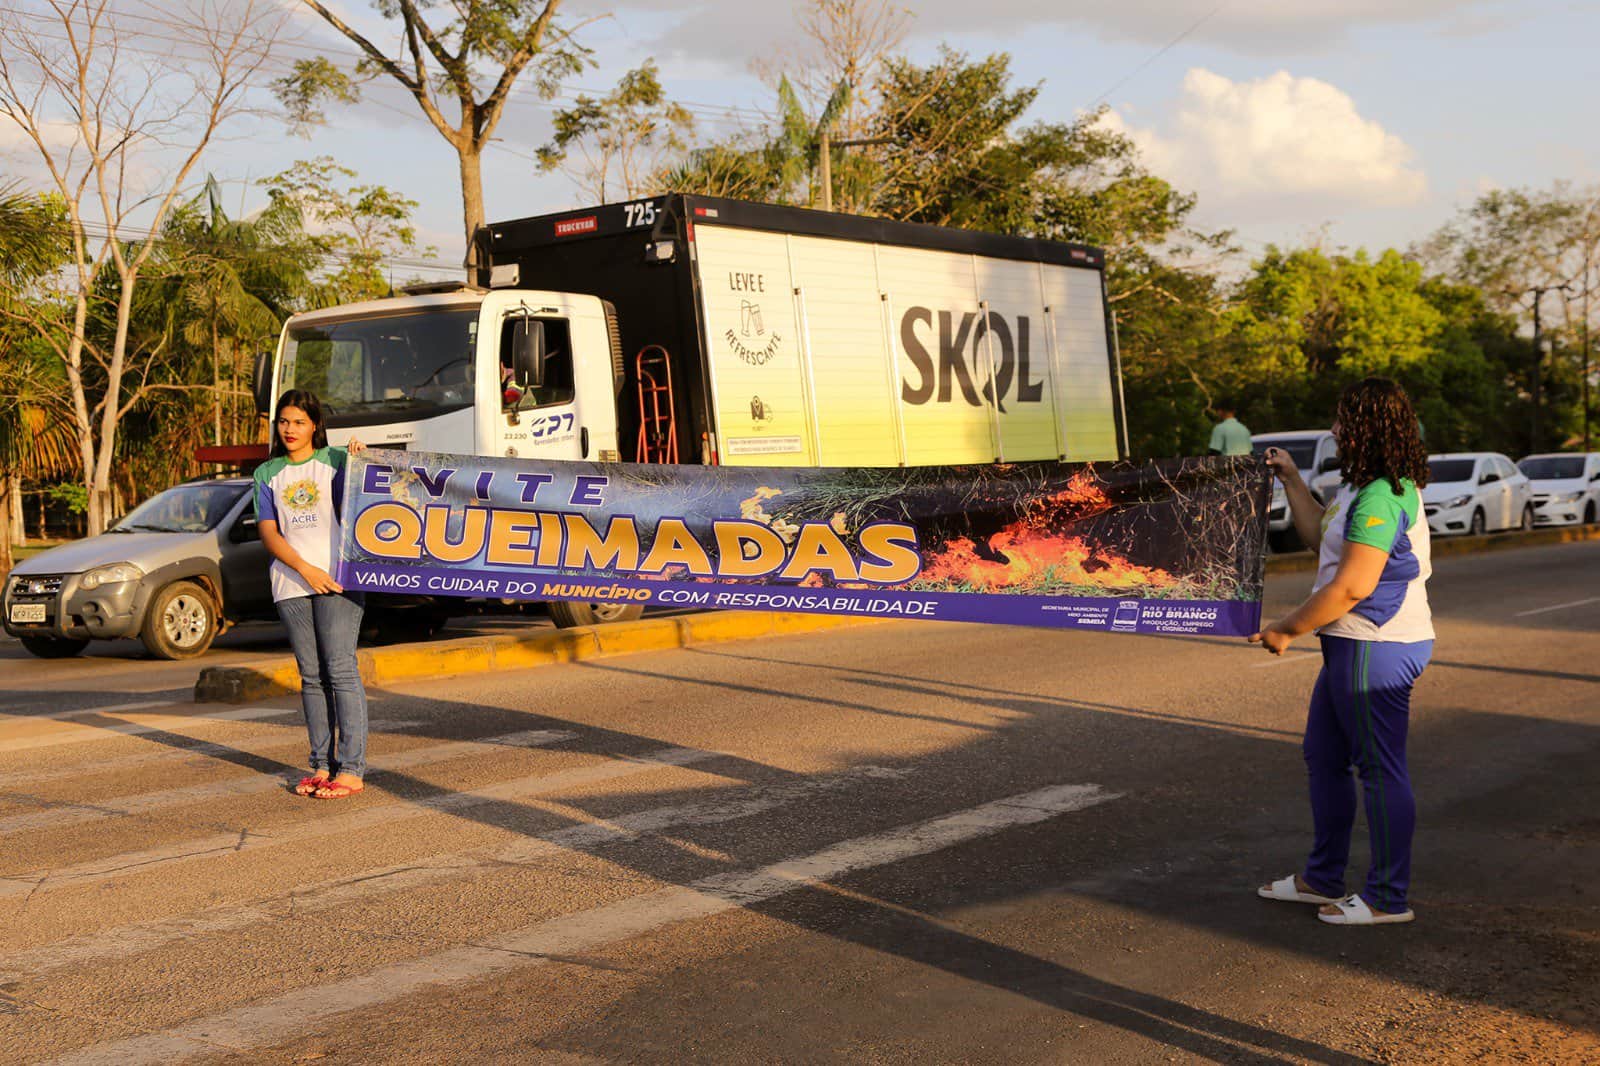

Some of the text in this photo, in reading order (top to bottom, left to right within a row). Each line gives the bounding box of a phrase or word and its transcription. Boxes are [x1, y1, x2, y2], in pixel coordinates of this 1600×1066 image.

[729, 271, 765, 293] LEVE E
[725, 329, 781, 366] REFRESCANTE
[362, 463, 609, 506] EVITE
[292, 513, 318, 524] ACRE
[353, 502, 922, 584] QUEIMADAS
[355, 571, 939, 616] VAMOS CUIDAR DO MUNICÍPIO COM RESPONSABILIDADE
[1142, 619, 1181, 627] PRODUÇÃO,
[1166, 611, 1217, 620] BRANCO
